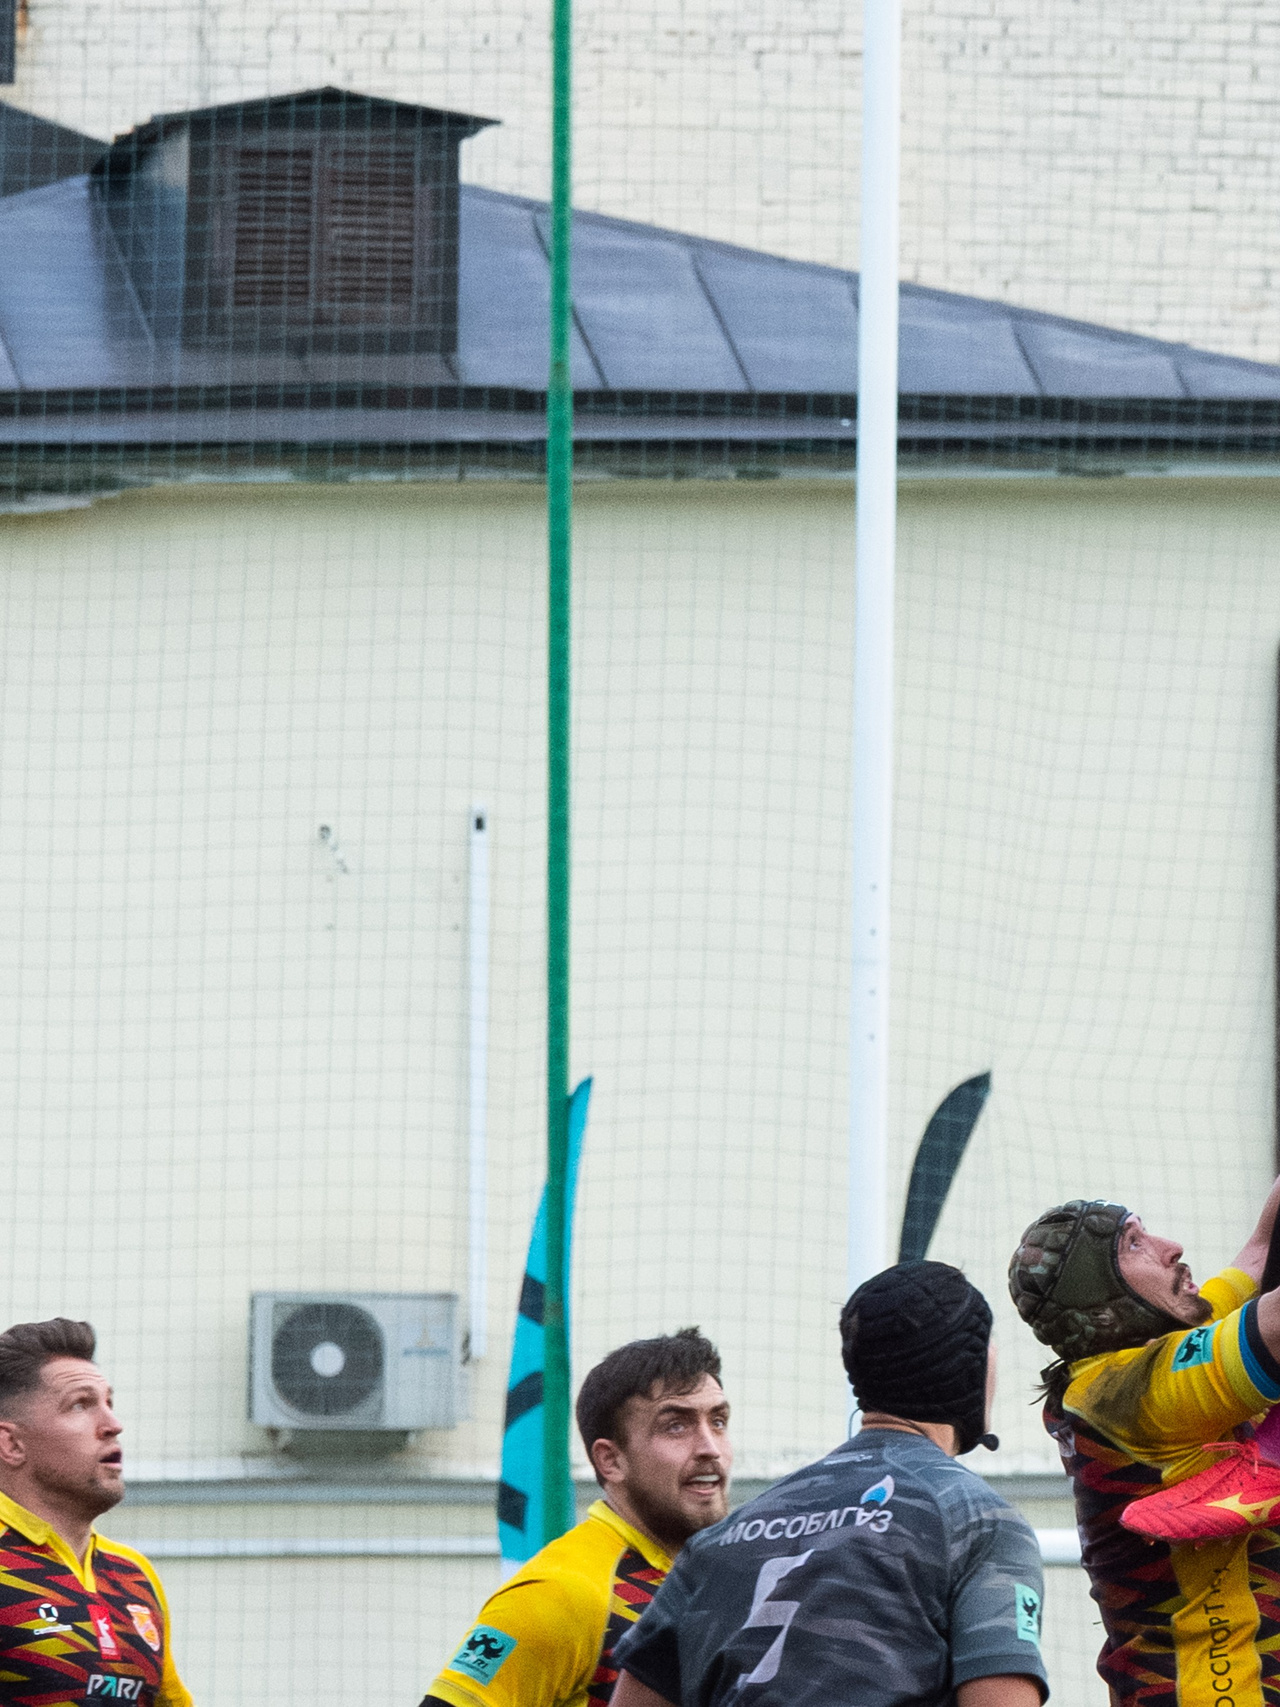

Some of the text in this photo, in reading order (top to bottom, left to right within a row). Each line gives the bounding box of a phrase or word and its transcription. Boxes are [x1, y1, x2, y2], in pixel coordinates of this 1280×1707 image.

[719, 1506, 893, 1545] МОСОБЛГАЗ
[737, 1549, 815, 1690] 5
[86, 1674, 143, 1700] PARI
